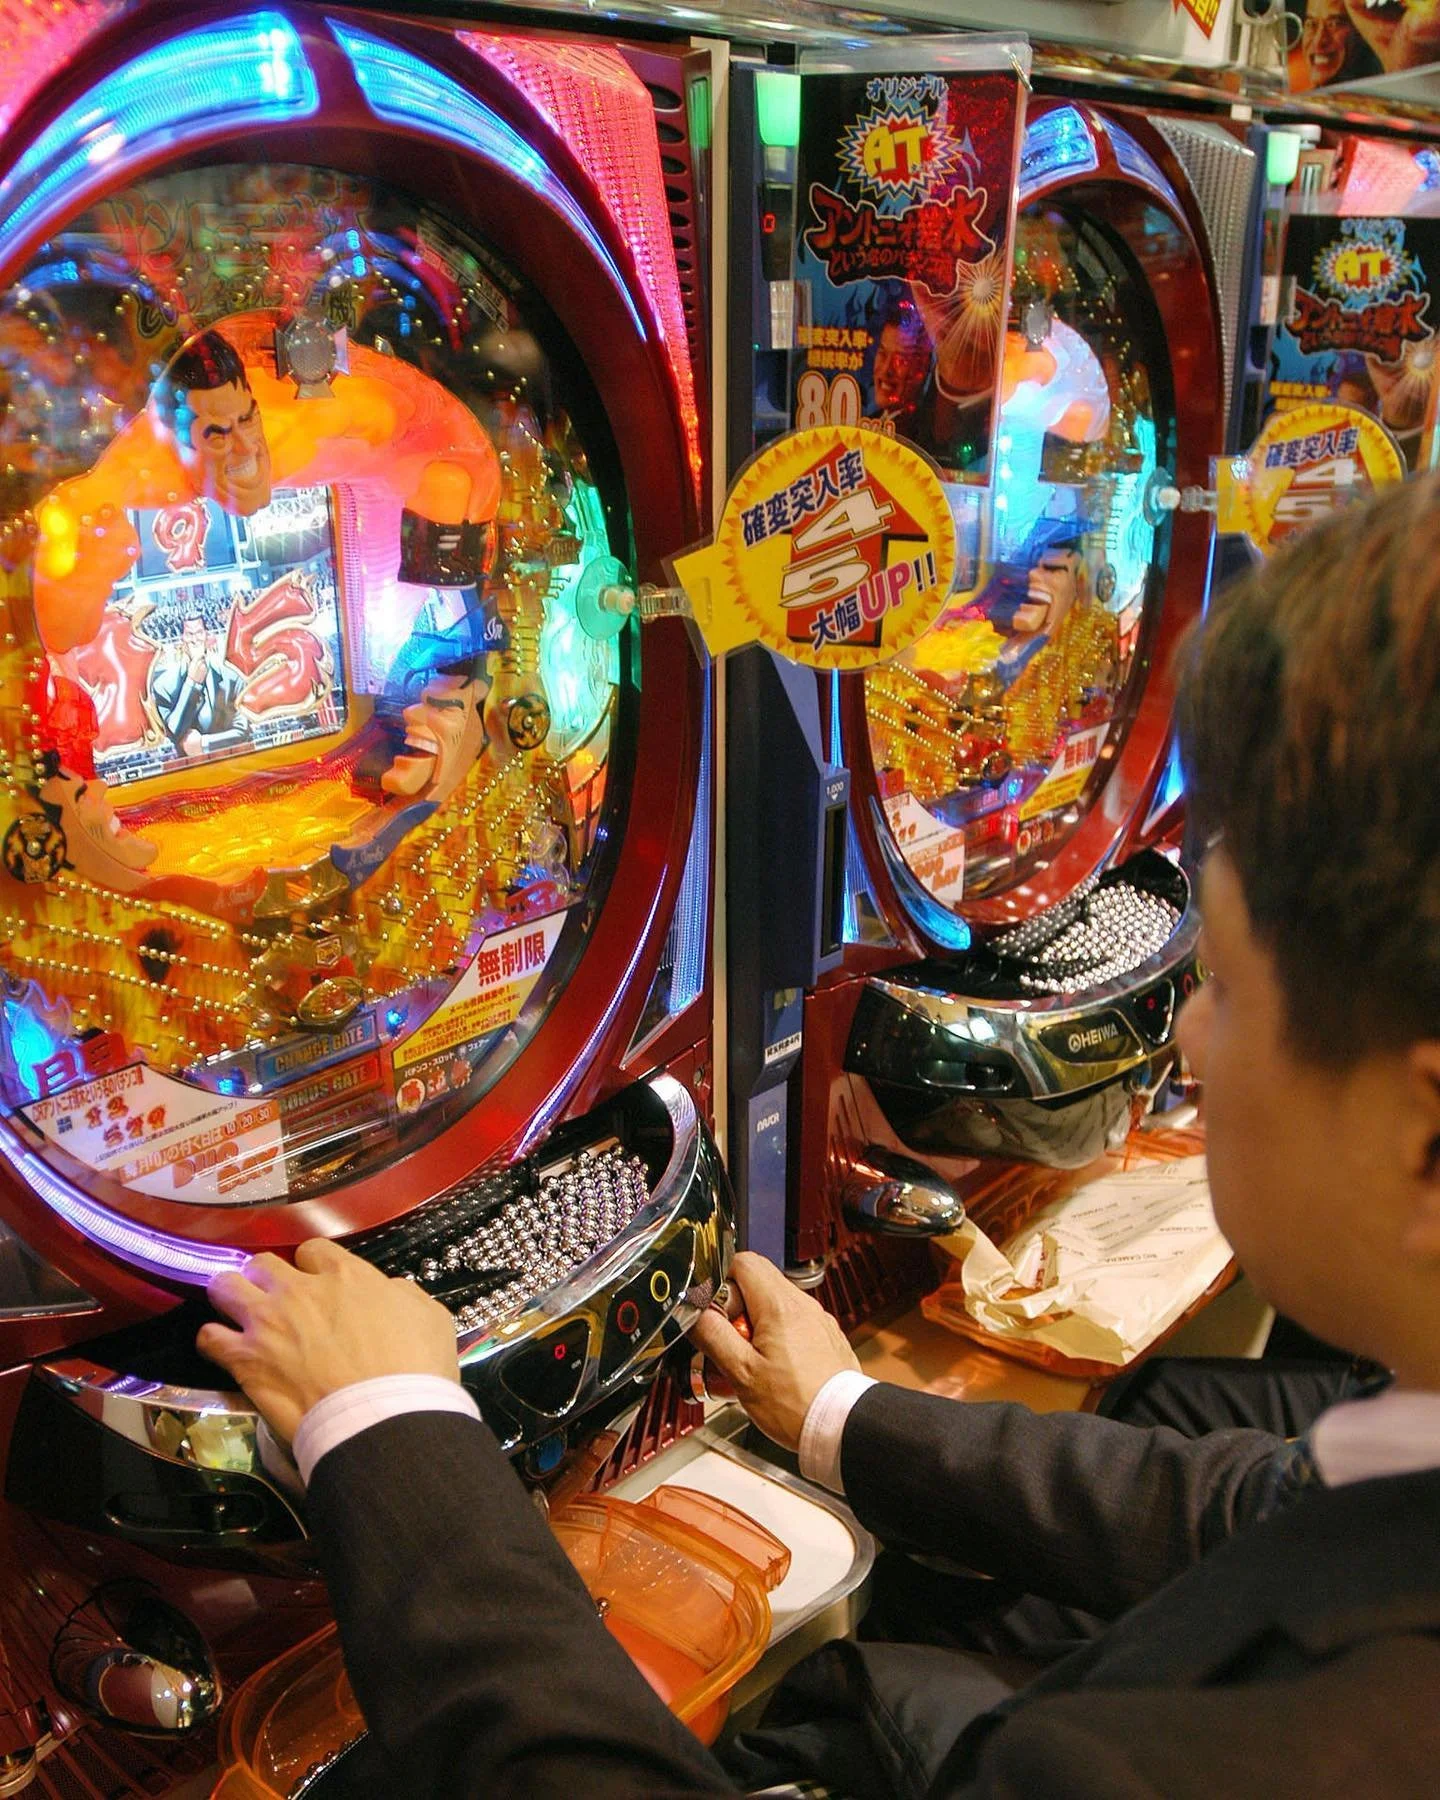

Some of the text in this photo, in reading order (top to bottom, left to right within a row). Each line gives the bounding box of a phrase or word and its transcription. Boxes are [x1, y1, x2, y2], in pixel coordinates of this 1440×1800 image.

[866, 77, 949, 101] オリジナル
[863, 126, 929, 177] AT
[1335, 250, 1387, 285] AT
[740, 449, 866, 547] 確変突入率
[477, 930, 546, 987] 無制限
[333, 1025, 363, 1050] GATE
[1081, 1022, 1119, 1048] HEIWA
[333, 1065, 368, 1090] GATE
